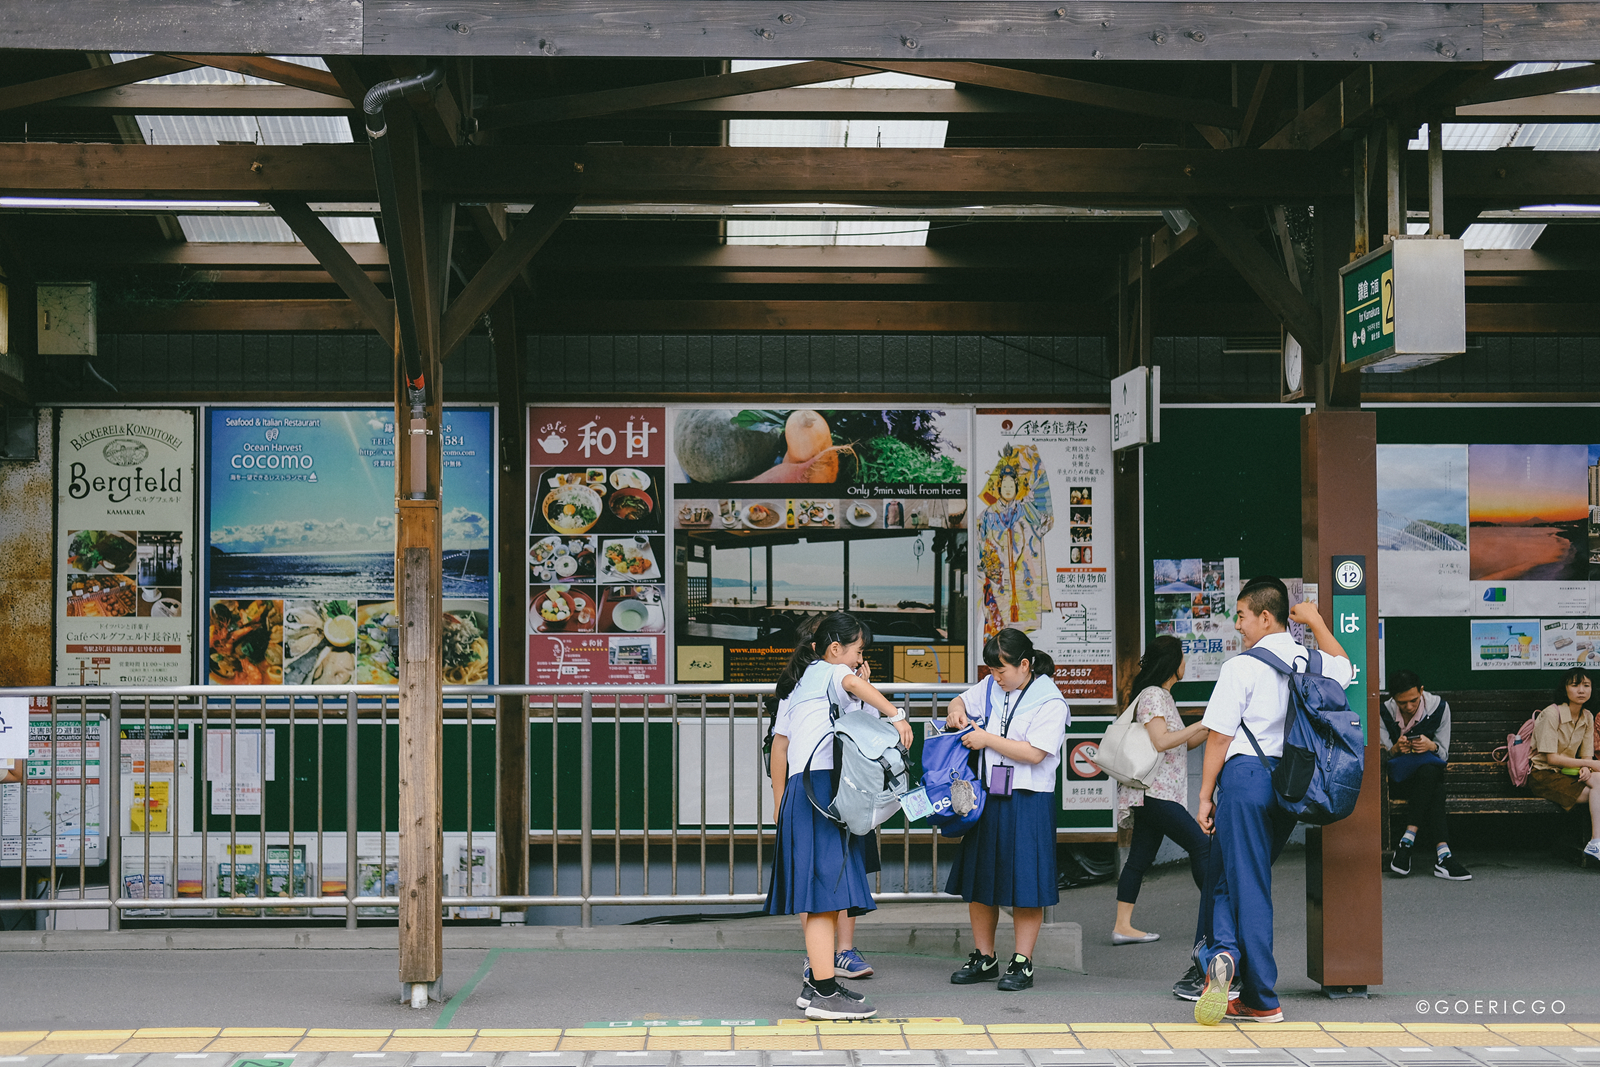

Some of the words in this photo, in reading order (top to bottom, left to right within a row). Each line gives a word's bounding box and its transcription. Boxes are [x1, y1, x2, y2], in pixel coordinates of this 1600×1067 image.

[1385, 279, 1393, 324] 2
[1364, 307, 1380, 320] Kamakura
[226, 417, 254, 427] Seafood
[255, 418, 260, 427] &
[262, 418, 283, 427] Italian
[284, 418, 320, 427] Restaurant
[540, 420, 567, 434] café
[70, 425, 118, 451] BÄCKEREI
[126, 424, 183, 449] KONDITOREI
[243, 443, 270, 452] Ocean
[271, 443, 302, 452] Harvest
[231, 454, 313, 469] cocomo
[69, 462, 181, 503] Bergfeld
[847, 485, 870, 498] Only
[873, 485, 896, 495] 5min.
[897, 485, 917, 495] walk
[918, 485, 939, 495] from
[941, 485, 961, 495] here
[1342, 572, 1357, 583] 12
